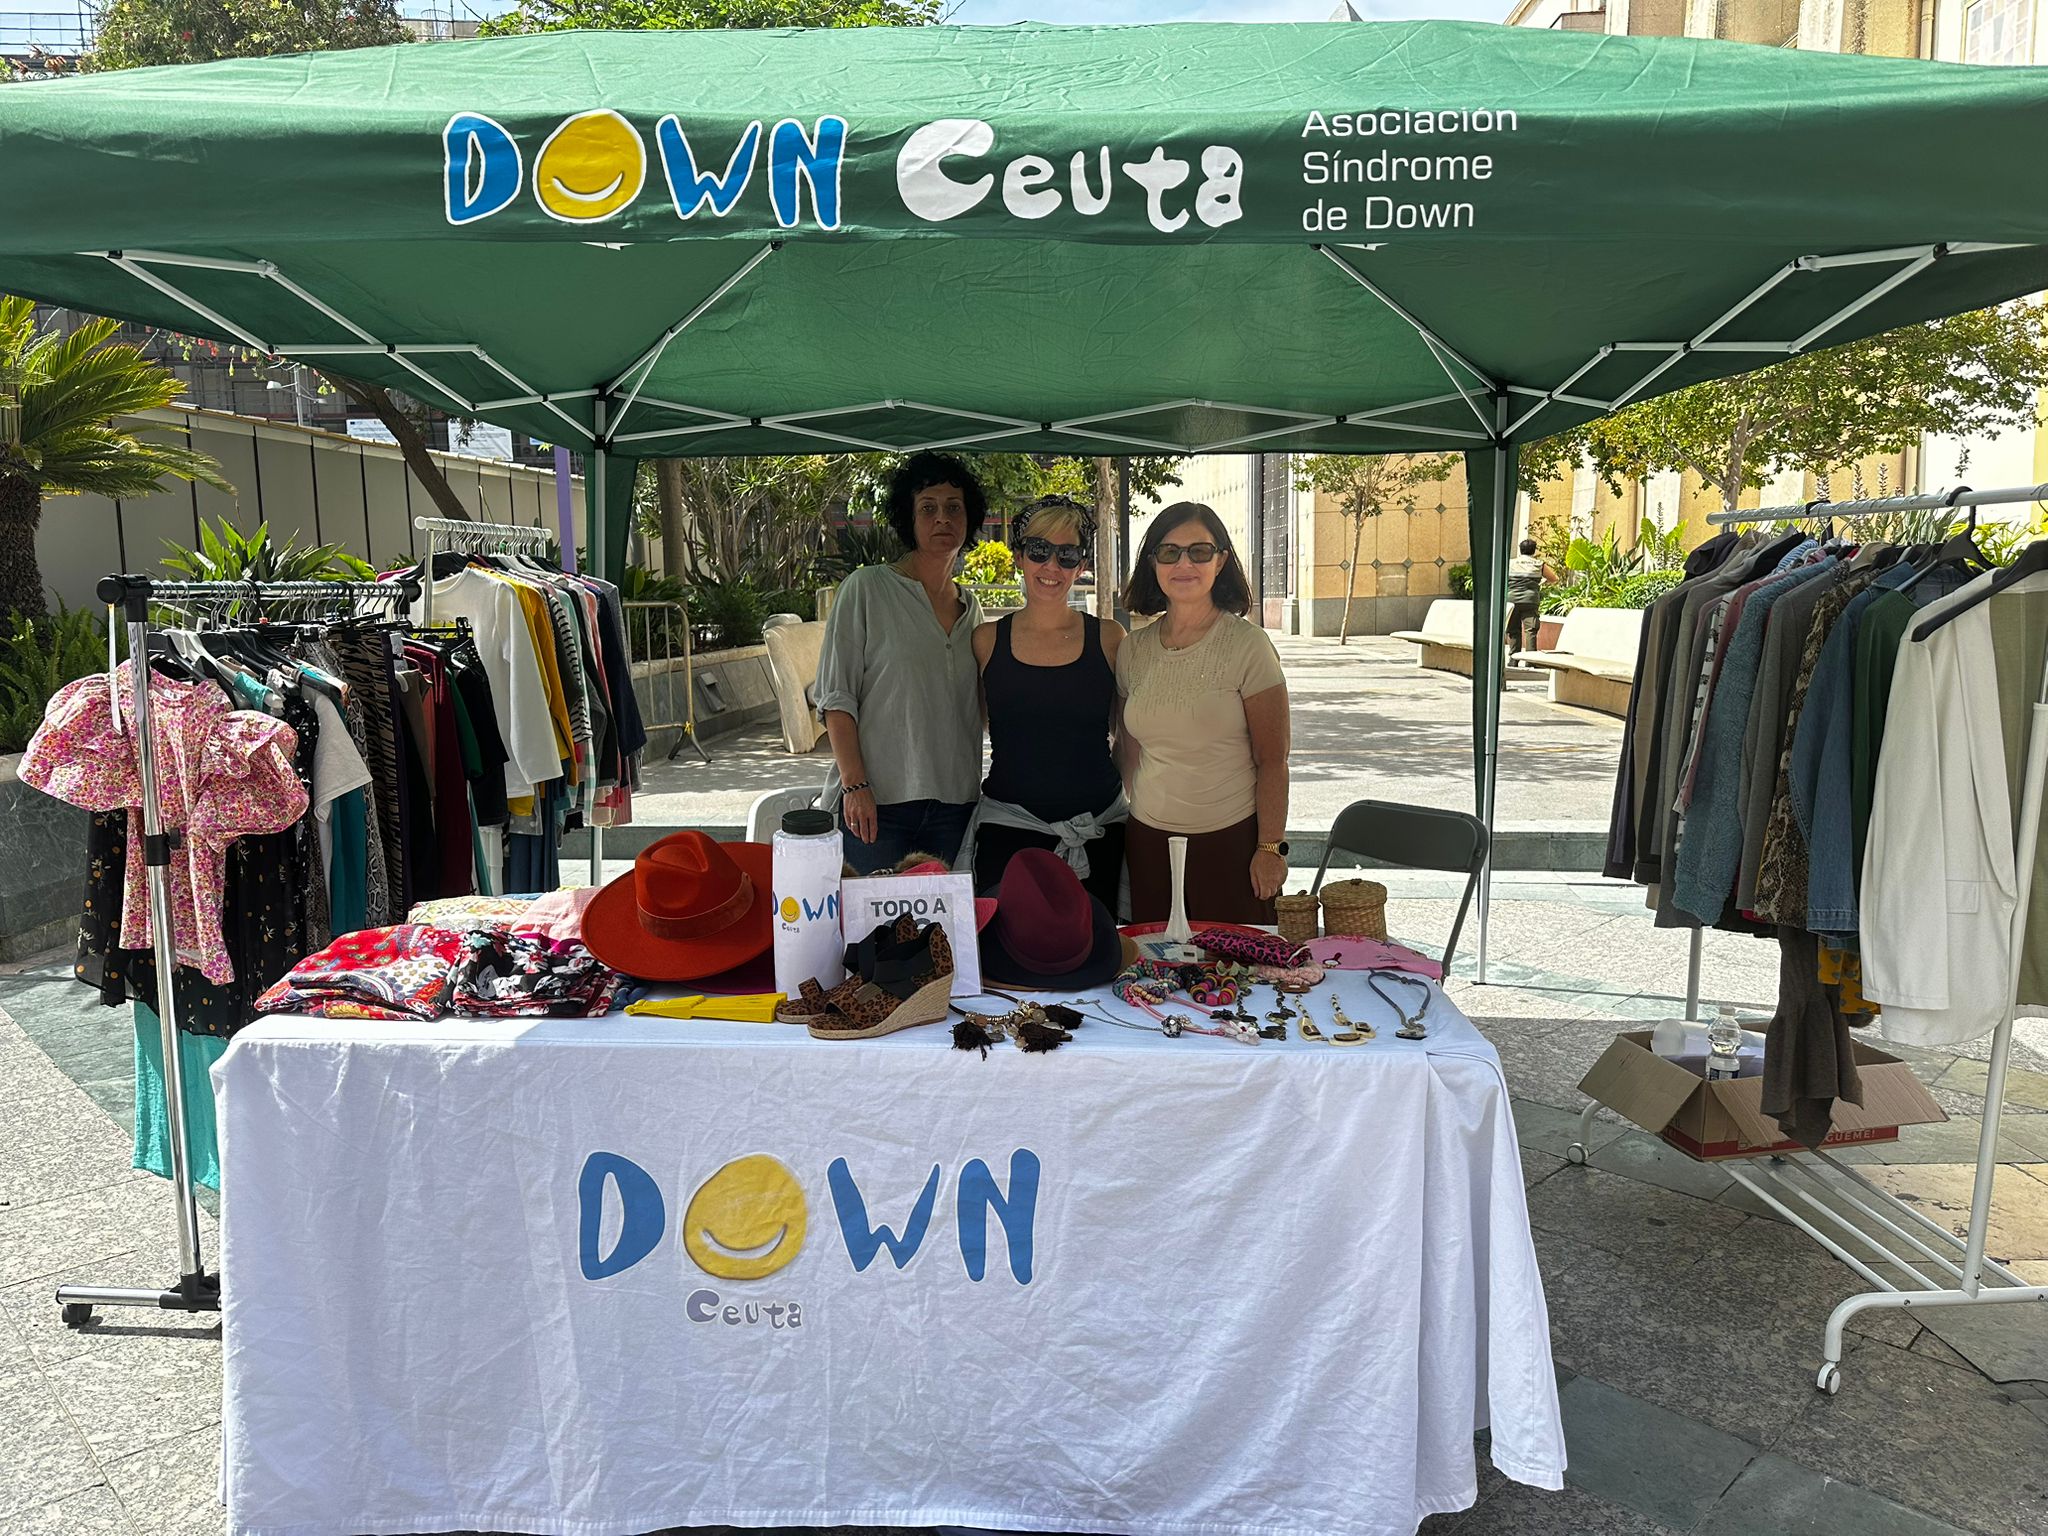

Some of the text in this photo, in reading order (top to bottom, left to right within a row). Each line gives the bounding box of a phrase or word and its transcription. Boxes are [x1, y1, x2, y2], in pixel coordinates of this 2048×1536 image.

[1301, 106, 1518, 138] Asociación
[443, 109, 1244, 232] DOWN Ceuta
[1302, 149, 1493, 184] Síndrome
[1302, 196, 1474, 231] de Down
[870, 897, 947, 917] TODO A
[1825, 1129, 1876, 1143] GUEME!
[578, 1148, 1041, 1285] DOWN
[686, 1289, 802, 1329] Ceuta
